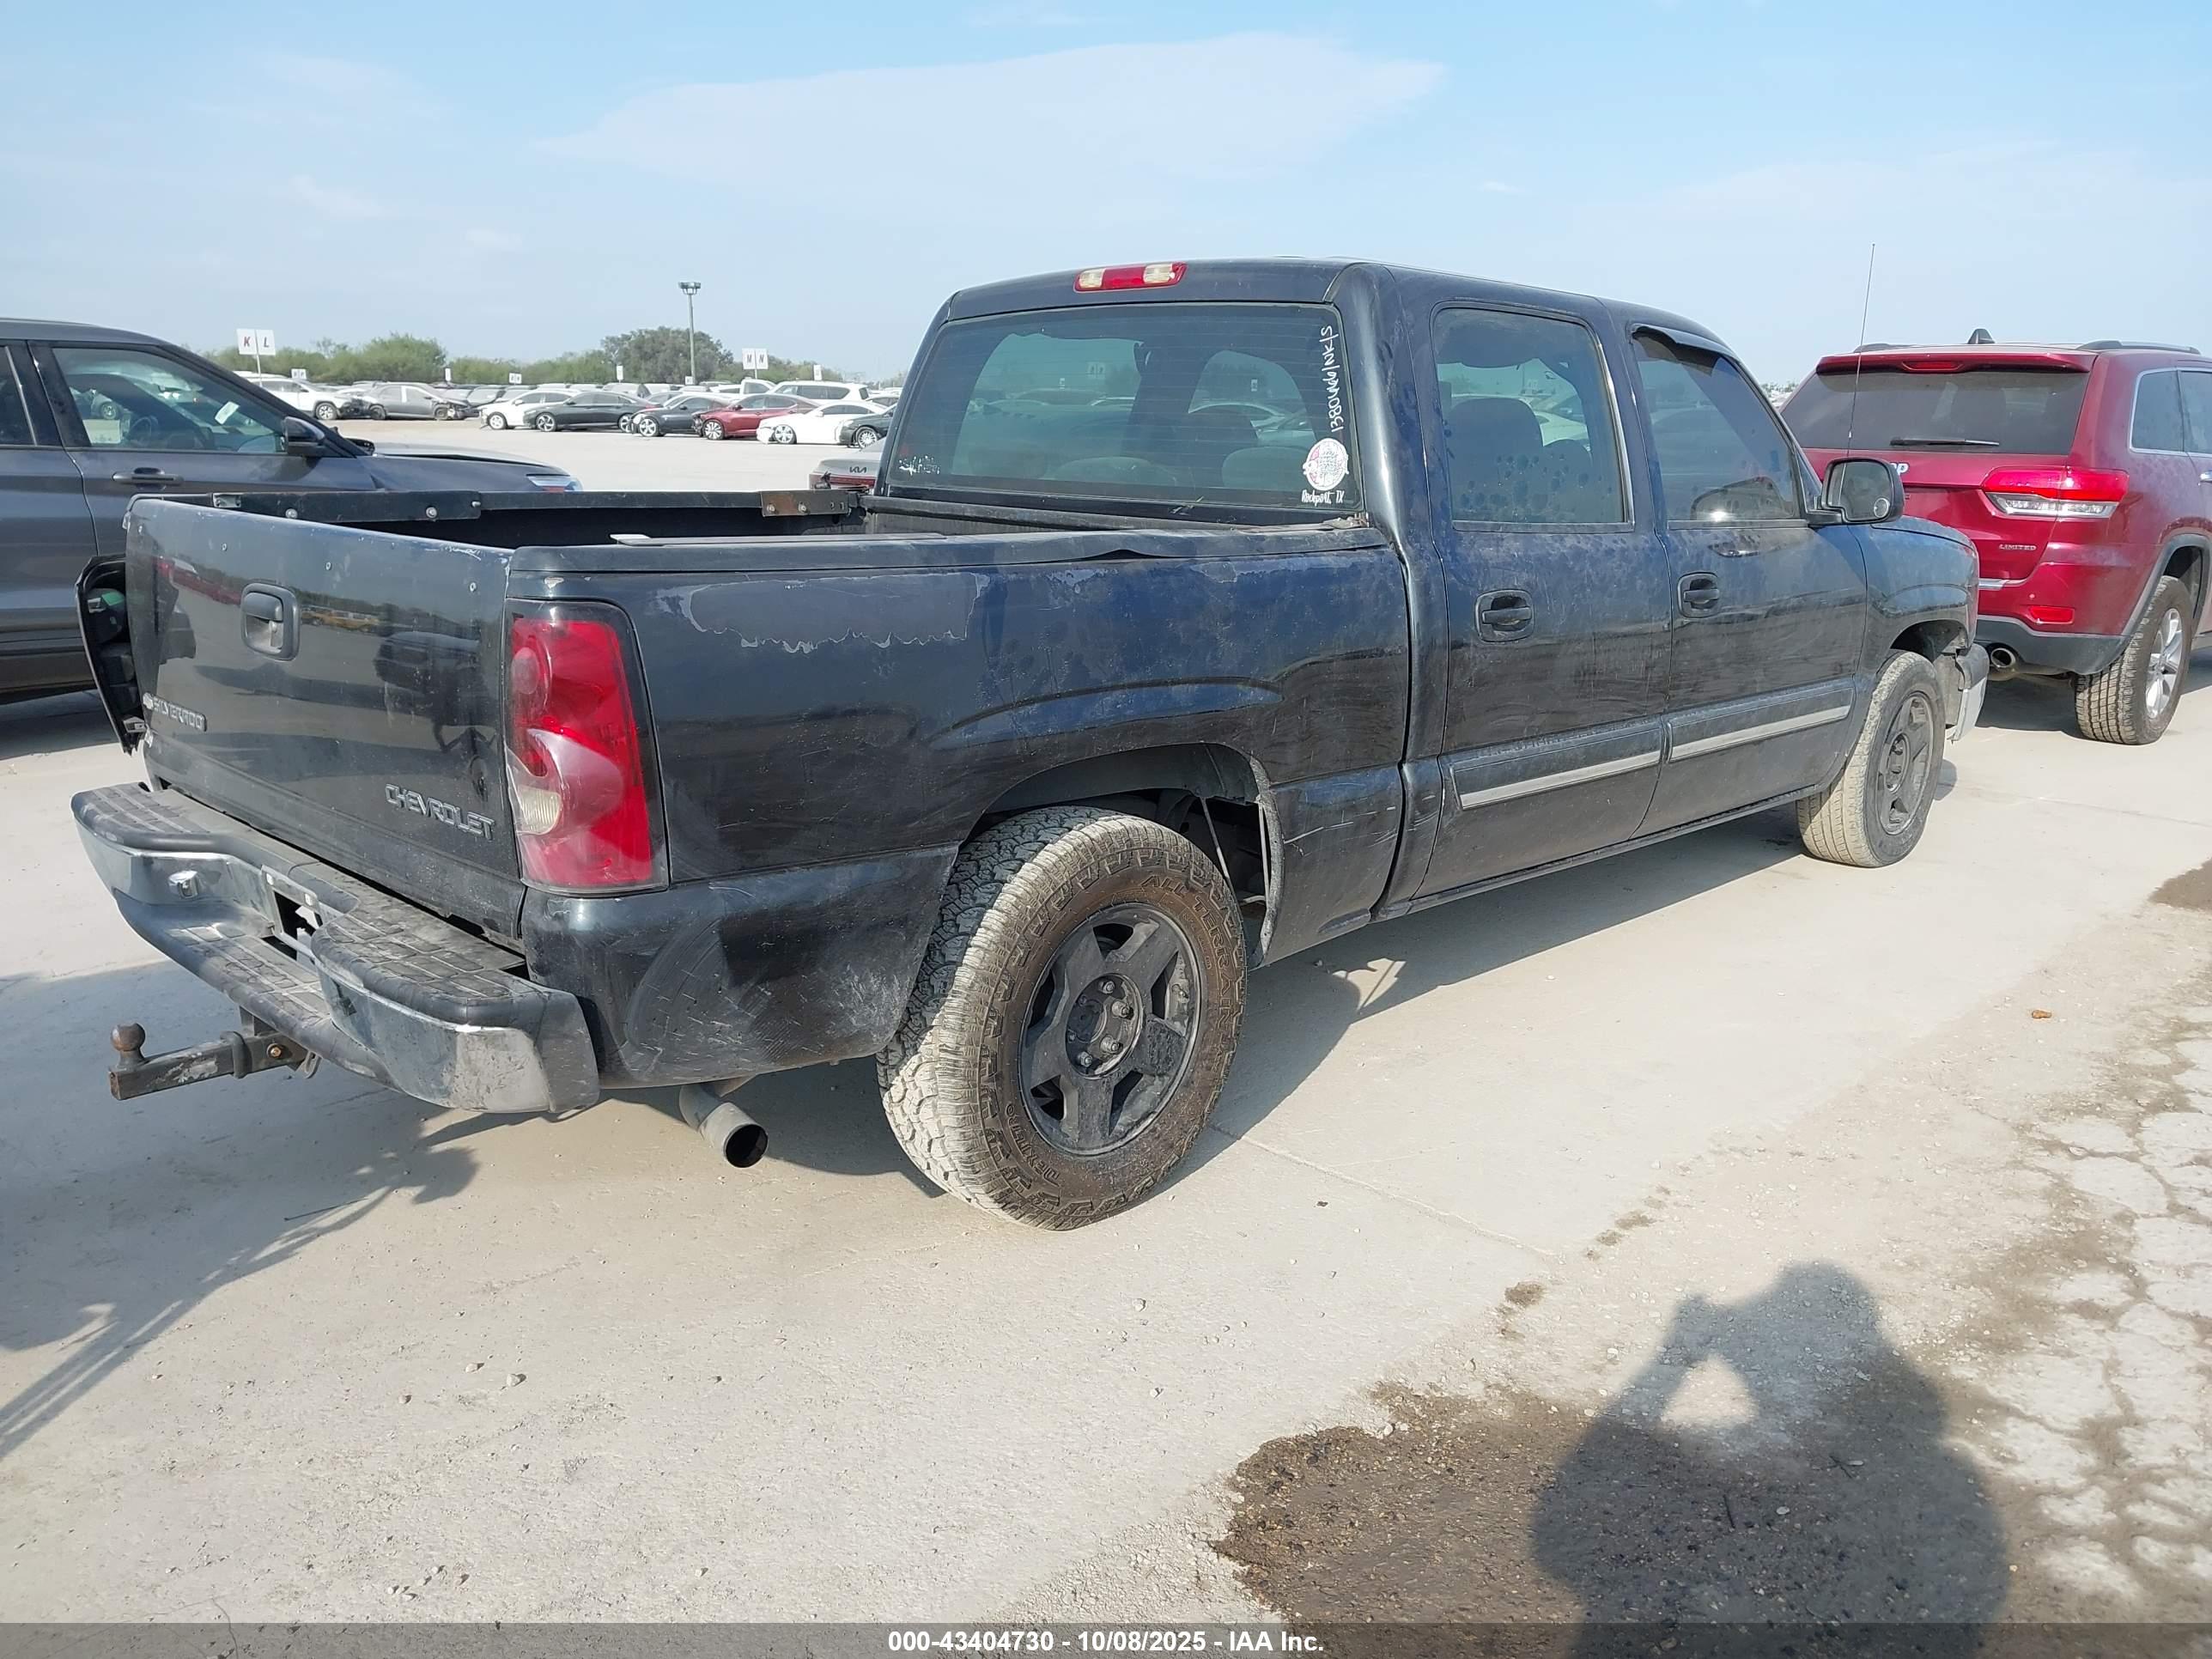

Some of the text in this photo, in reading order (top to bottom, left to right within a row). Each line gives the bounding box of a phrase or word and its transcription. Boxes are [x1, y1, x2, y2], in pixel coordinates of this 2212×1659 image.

[244, 337, 250, 347] K
[264, 337, 269, 347] L
[1335, 489, 1346, 503] TX
[153, 696, 204, 730] SILVERADO
[385, 783, 495, 842] CHEVROLET
[1141, 874, 1188, 898] ALL
[1194, 895, 1233, 1030] TERRAIN
